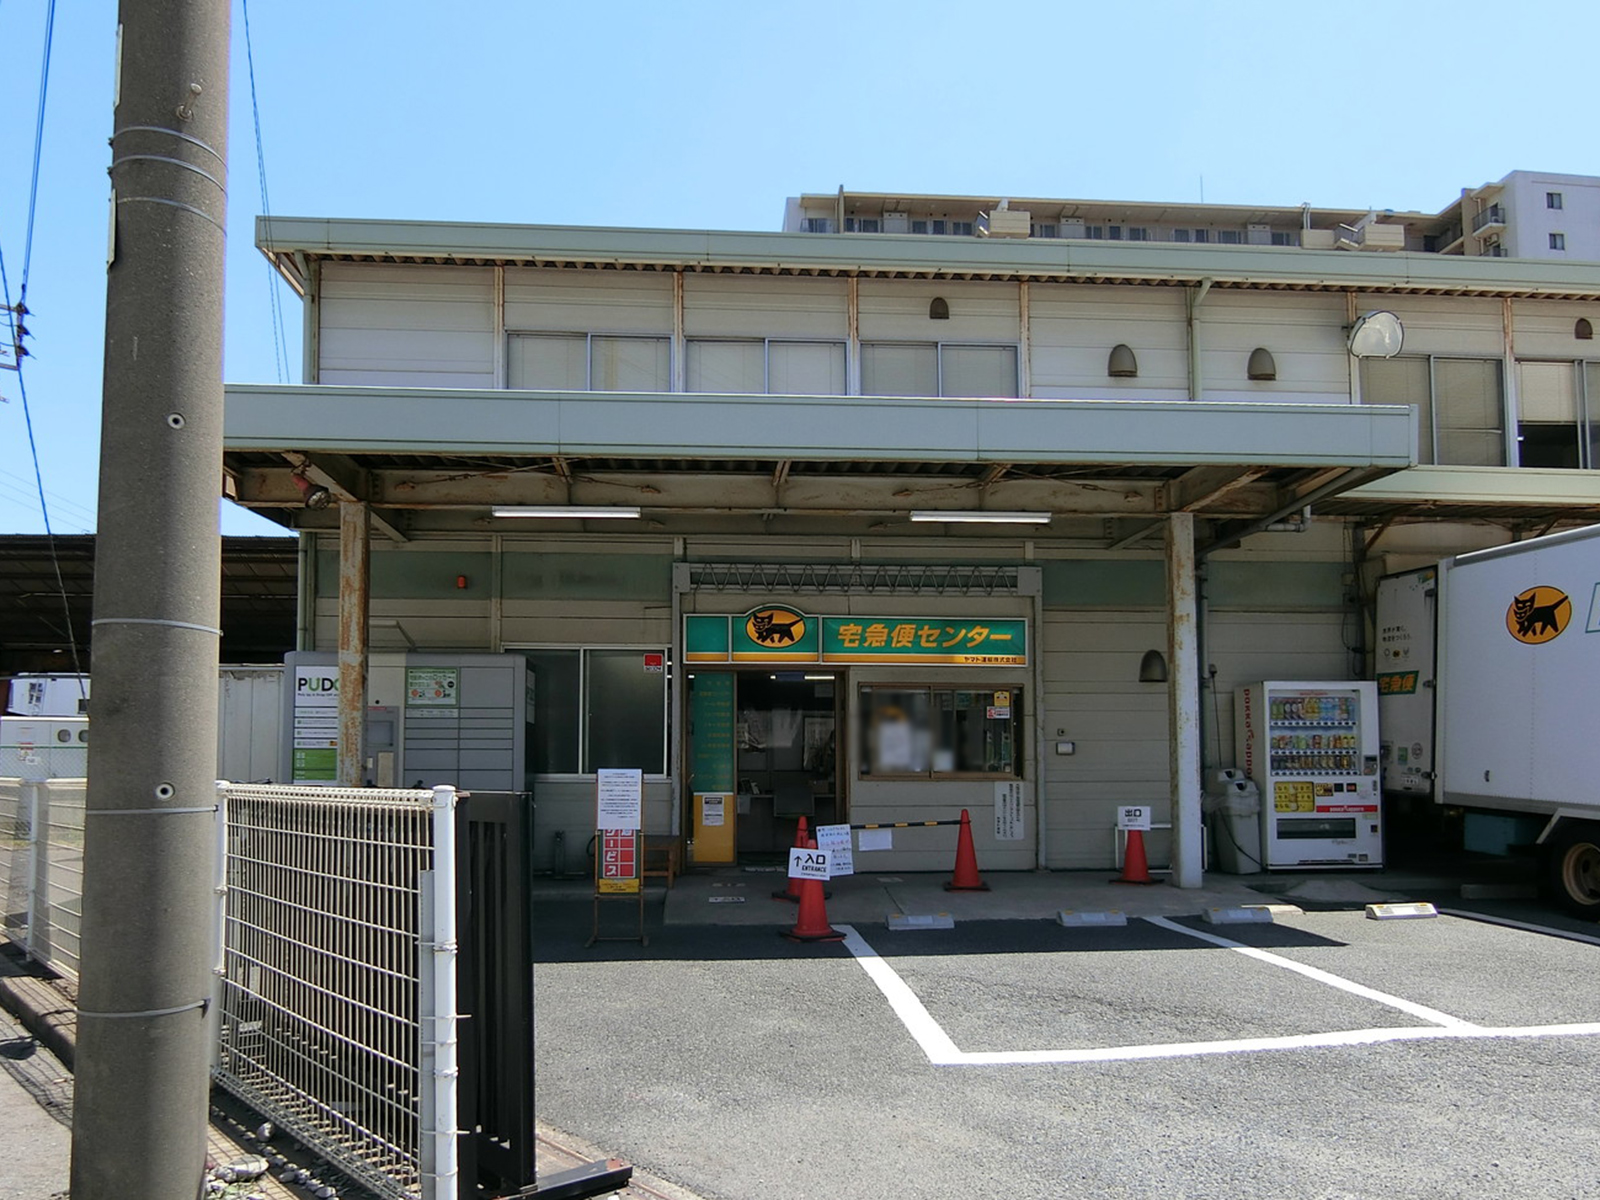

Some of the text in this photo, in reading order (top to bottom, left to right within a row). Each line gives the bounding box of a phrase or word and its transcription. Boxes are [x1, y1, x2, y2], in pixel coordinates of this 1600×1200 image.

[837, 623, 1013, 649] 宅急便センター
[1379, 674, 1415, 692] 宅急便
[1124, 808, 1142, 817] 出口
[804, 853, 826, 865] 入口
[801, 865, 827, 873] ENTRANCE
